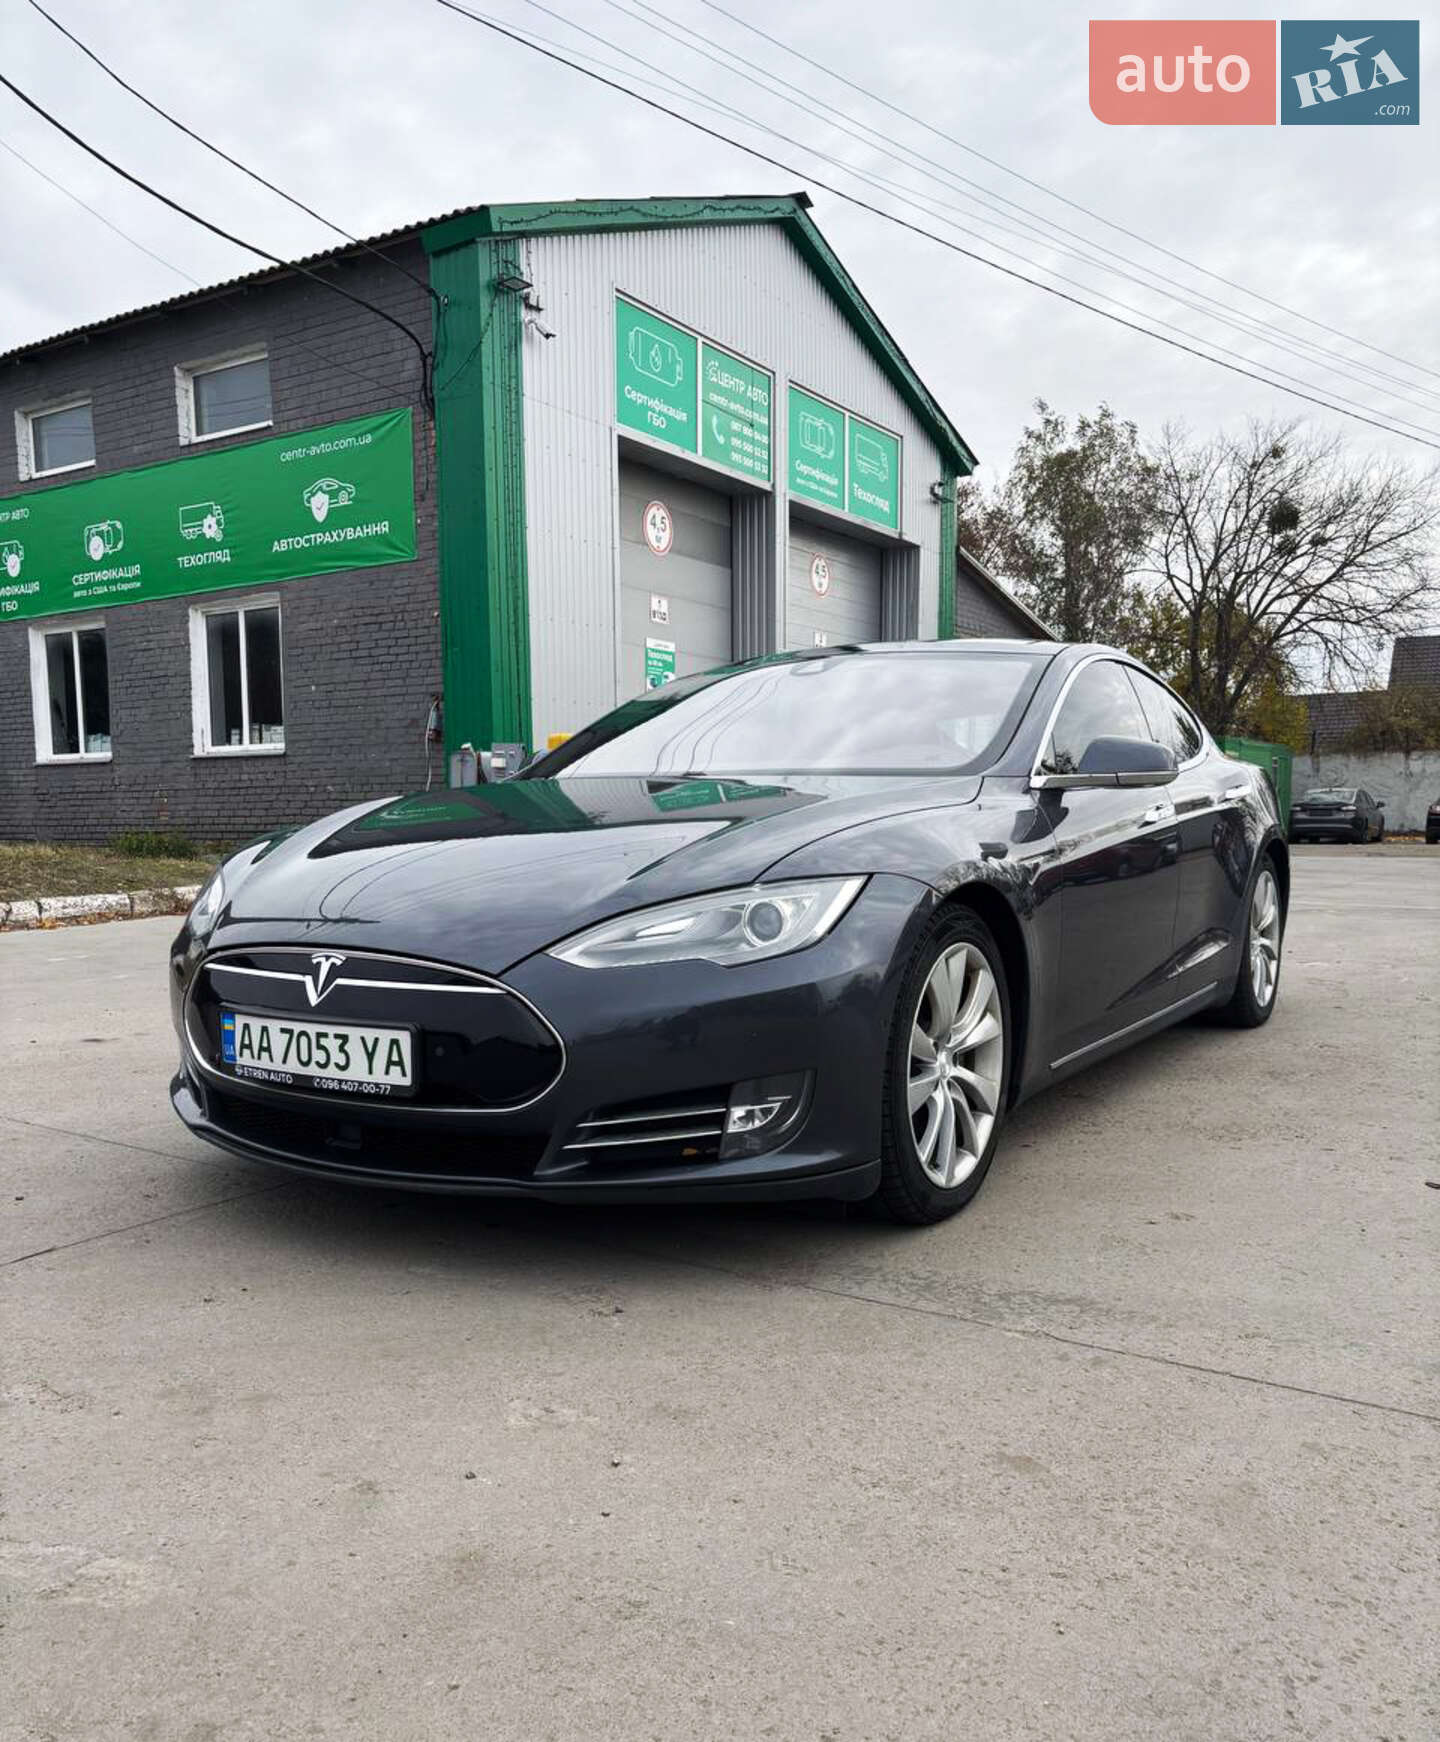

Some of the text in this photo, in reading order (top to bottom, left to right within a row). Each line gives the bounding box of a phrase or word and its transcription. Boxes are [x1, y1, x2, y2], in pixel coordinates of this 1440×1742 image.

[624, 385, 687, 422] Сертифікація
[747, 385, 768, 406] АВТО
[648, 410, 666, 429] ГБО
[280, 433, 372, 462] centr-avto.com.ua
[272, 521, 389, 553] АВТОСТРАХУВАННЯ
[176, 549, 231, 568] ТЕХОГЛЯД
[72, 564, 141, 586] СЕРТИФІКАЦІЯ
[269, 1072, 294, 1084] AUTO
